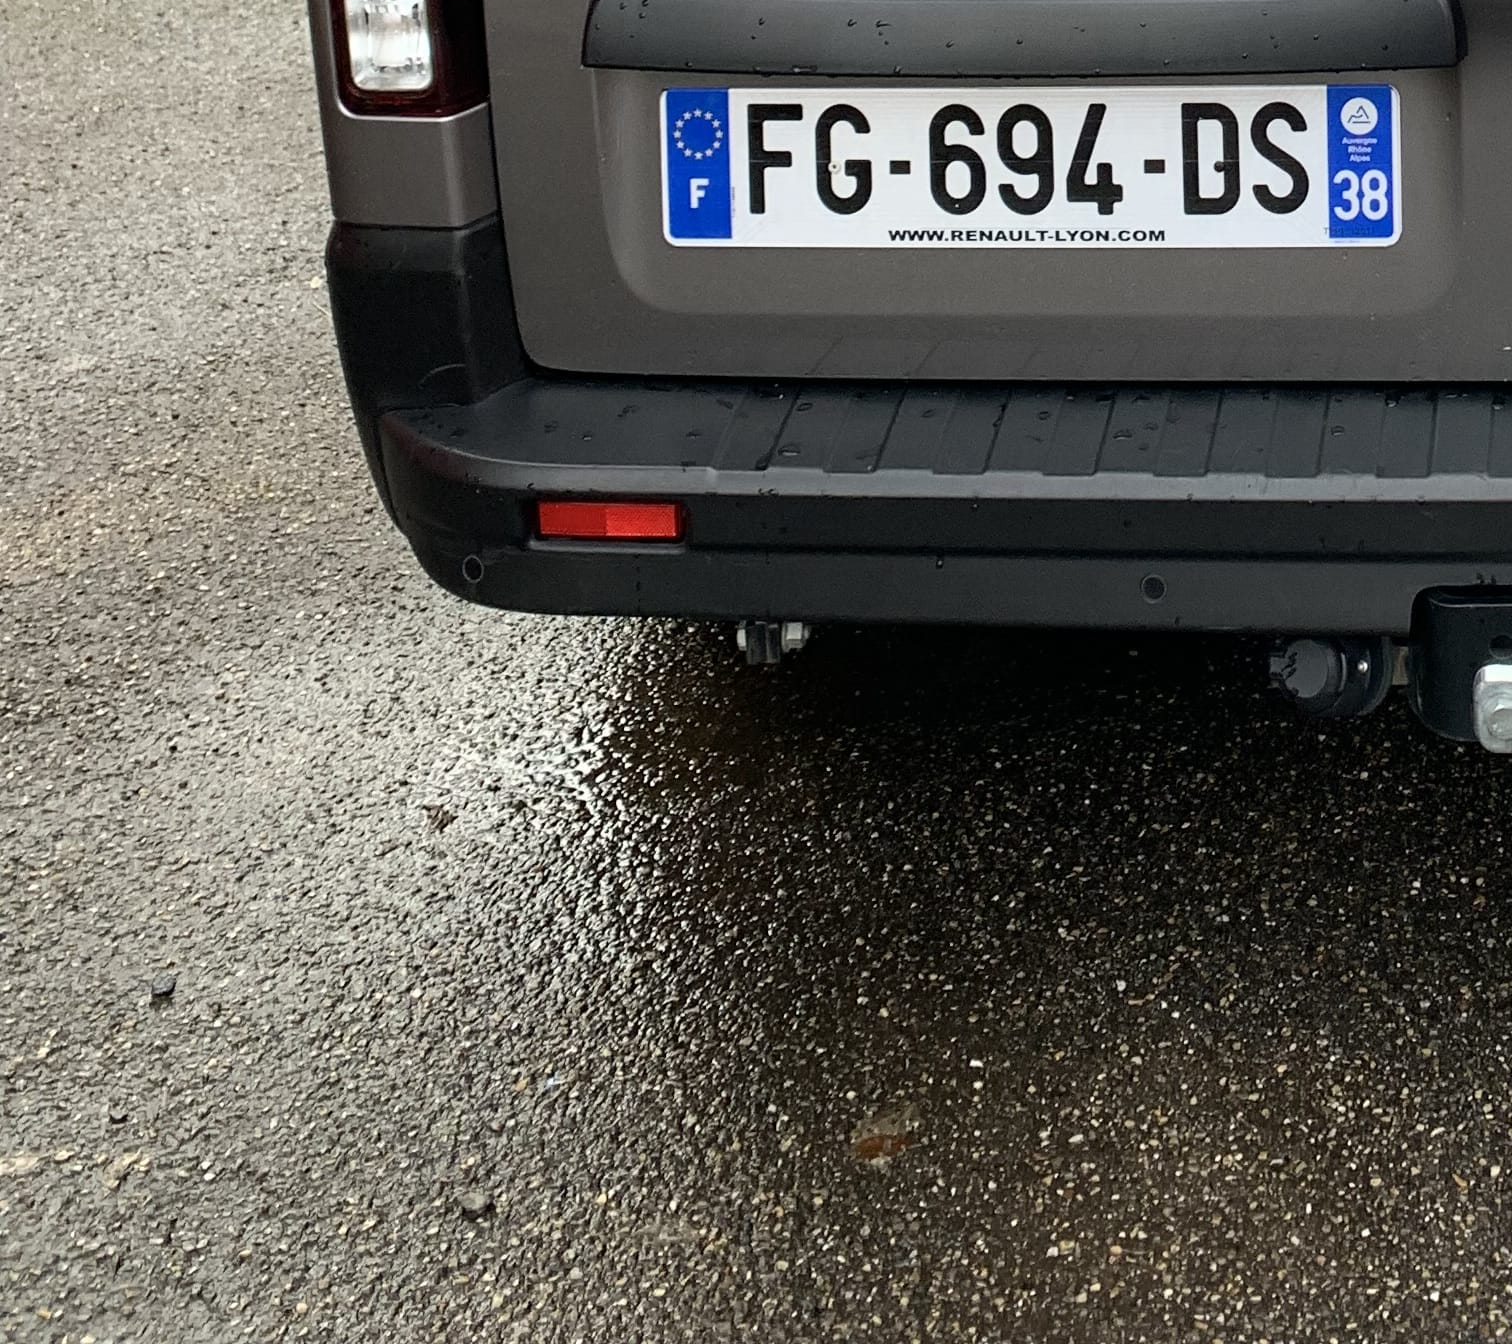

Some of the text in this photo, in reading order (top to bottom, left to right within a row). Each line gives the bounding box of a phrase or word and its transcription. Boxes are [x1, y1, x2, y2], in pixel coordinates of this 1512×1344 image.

[747, 102, 1309, 215] FG-694-DS
[690, 178, 709, 208] F
[1333, 169, 1388, 221] 38
[888, 229, 1166, 242] WWW.RENAULT-LYON.COM
